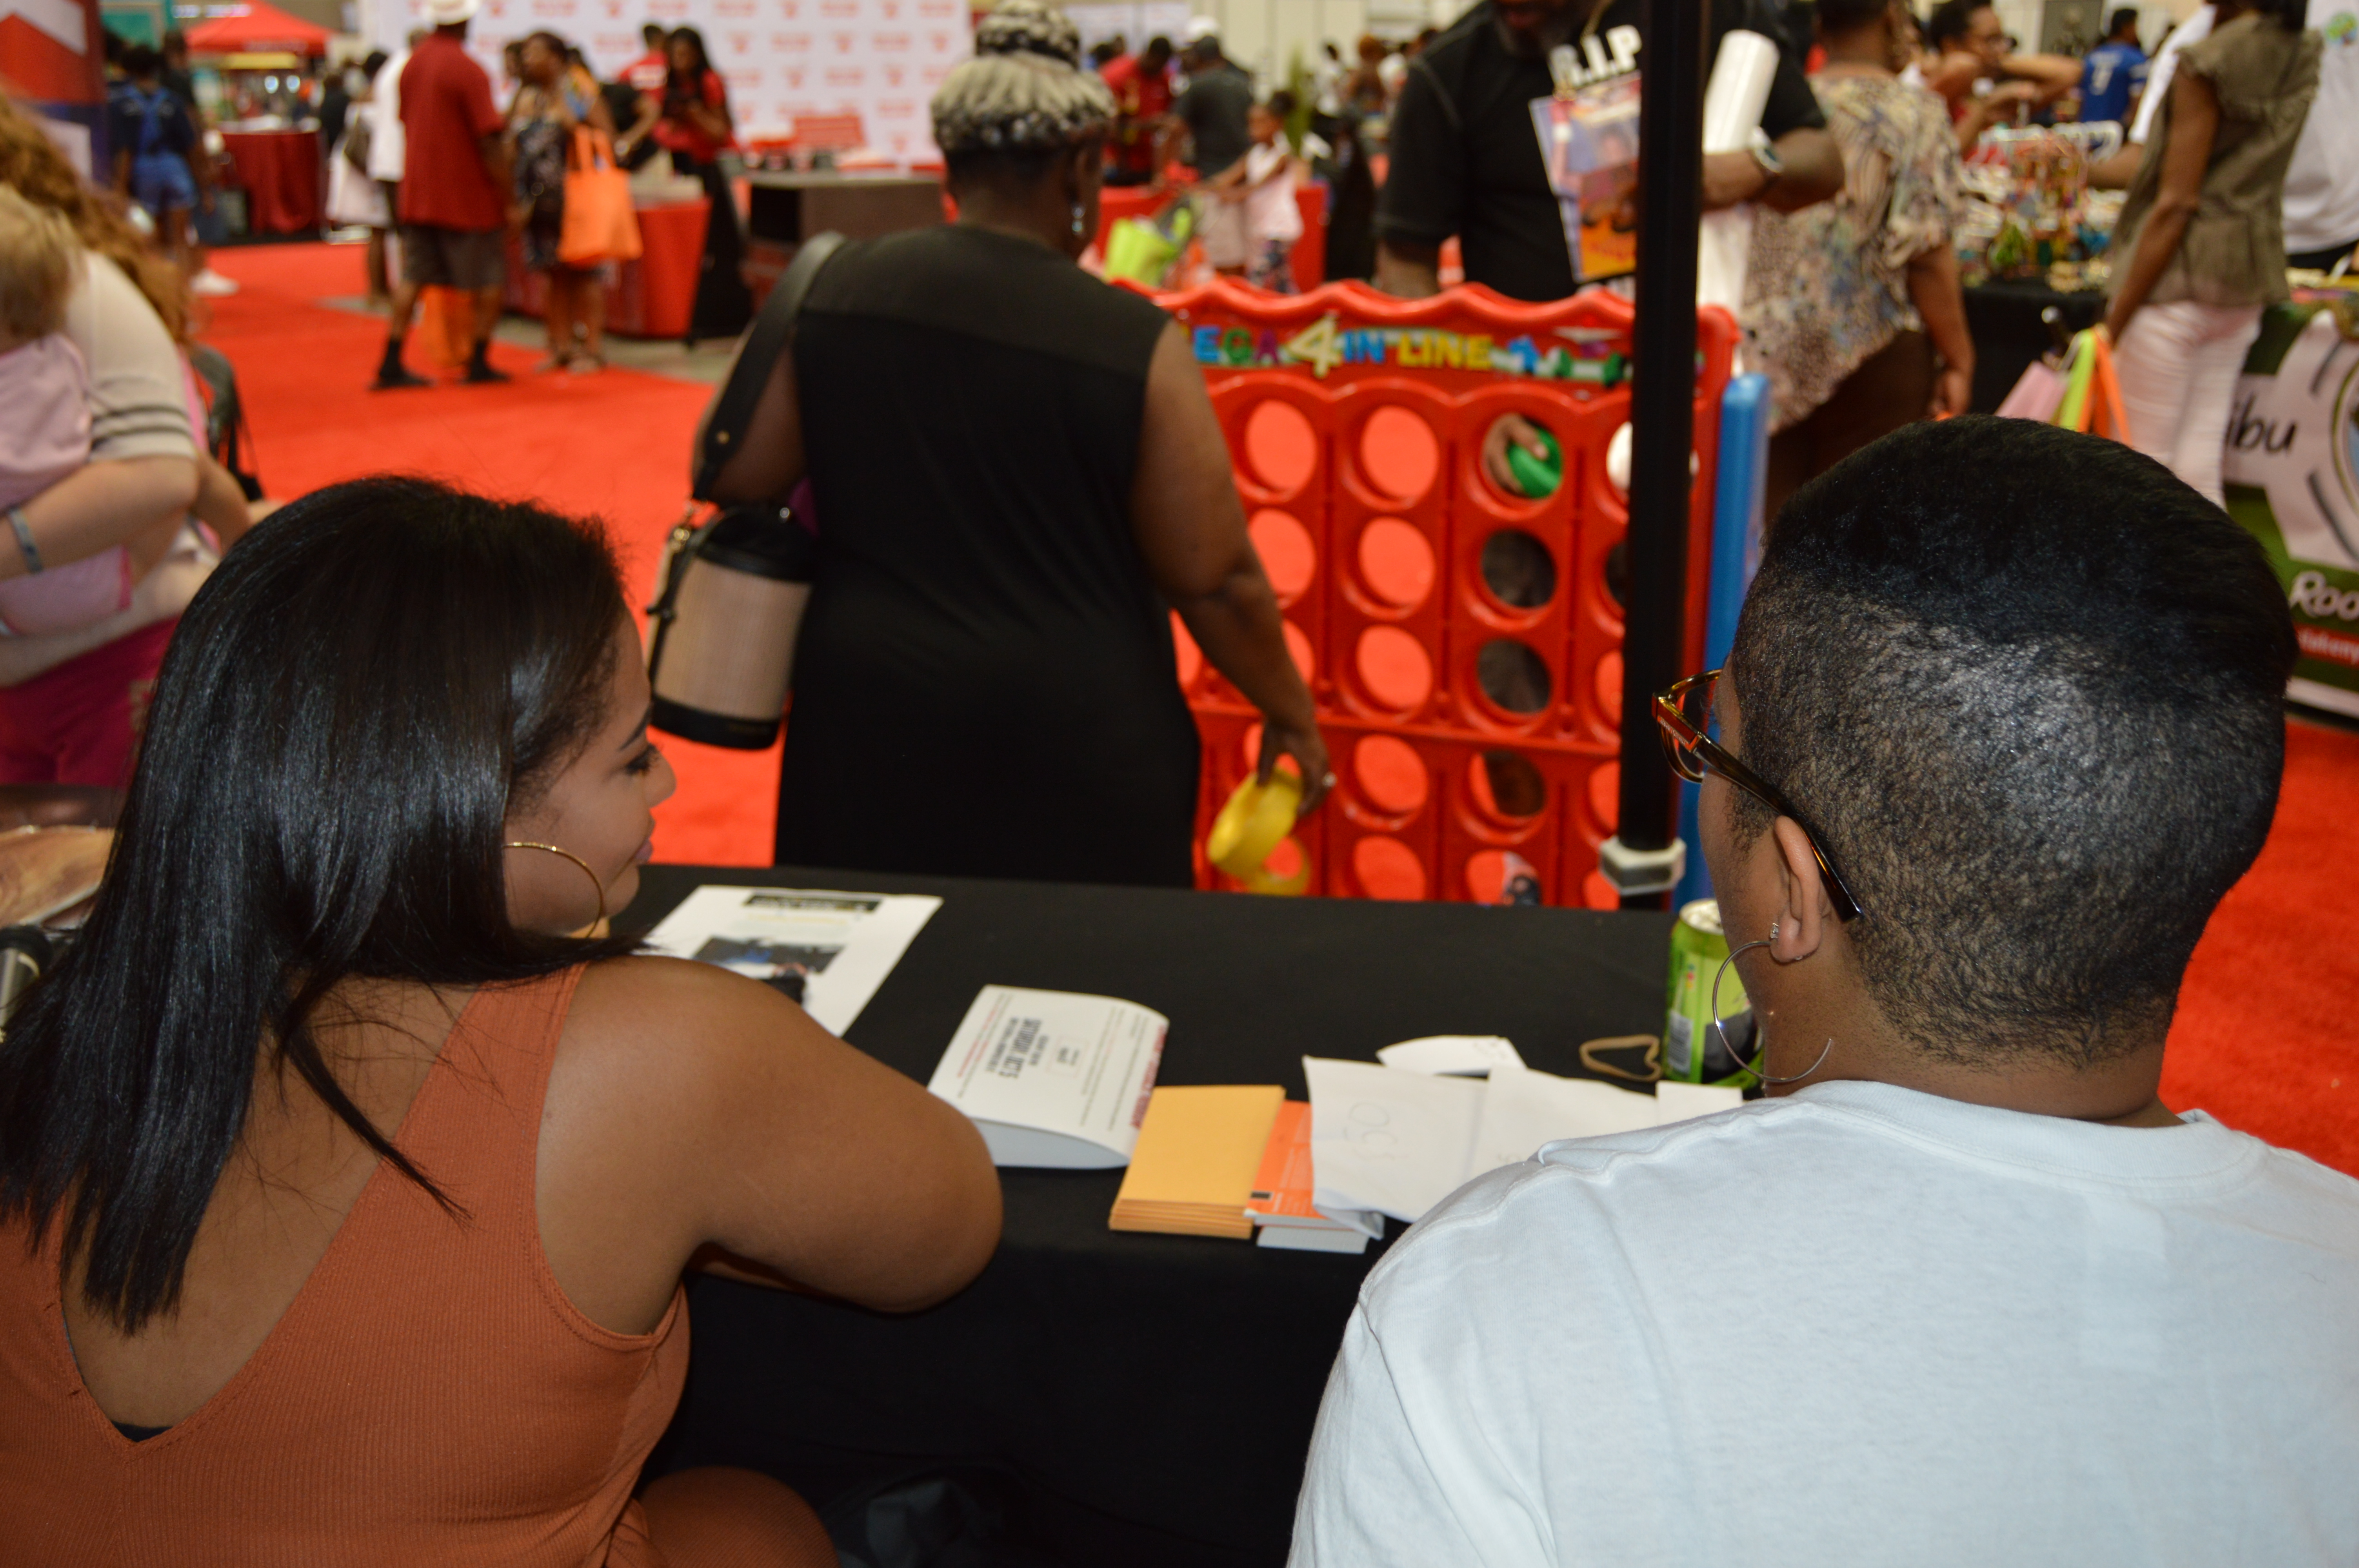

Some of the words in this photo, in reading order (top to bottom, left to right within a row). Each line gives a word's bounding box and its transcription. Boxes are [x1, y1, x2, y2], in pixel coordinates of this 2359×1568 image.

[1180, 325, 1281, 365] EGA
[1289, 310, 1343, 379] 4
[1343, 330, 1386, 365] IN
[1396, 332, 1495, 370] LINE
